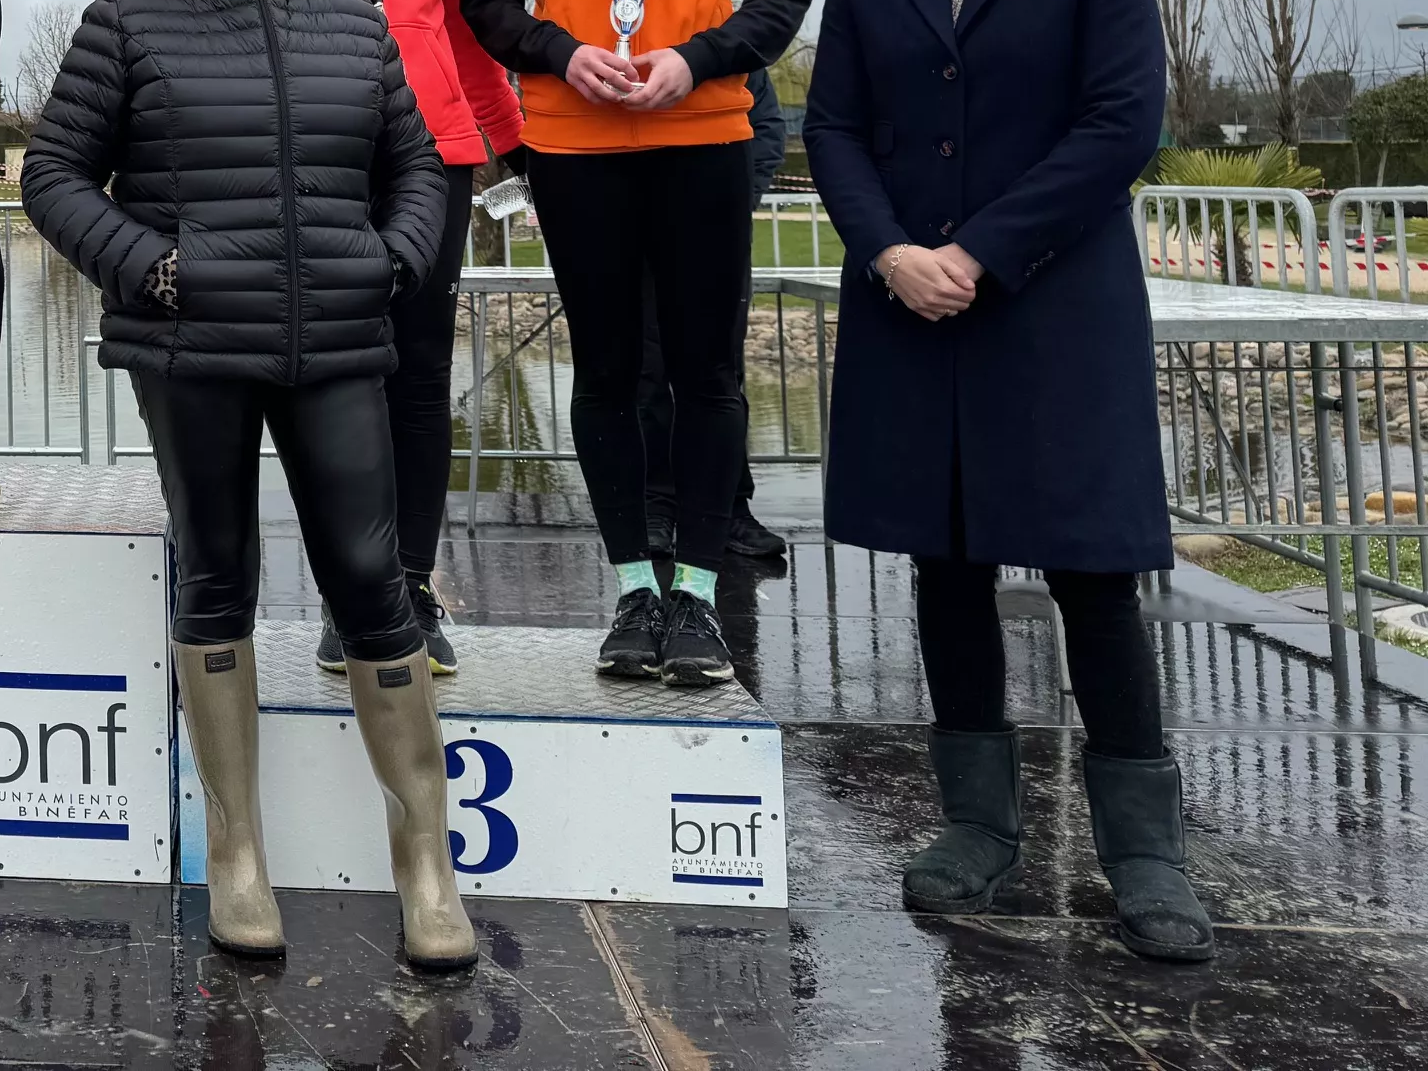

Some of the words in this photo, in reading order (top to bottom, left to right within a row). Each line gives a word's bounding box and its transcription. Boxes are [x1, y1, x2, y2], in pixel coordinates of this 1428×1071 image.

[18, 805, 129, 821] BINÉFAR
[444, 739, 519, 874] 3
[671, 808, 762, 858] bnf
[671, 865, 689, 873] DE
